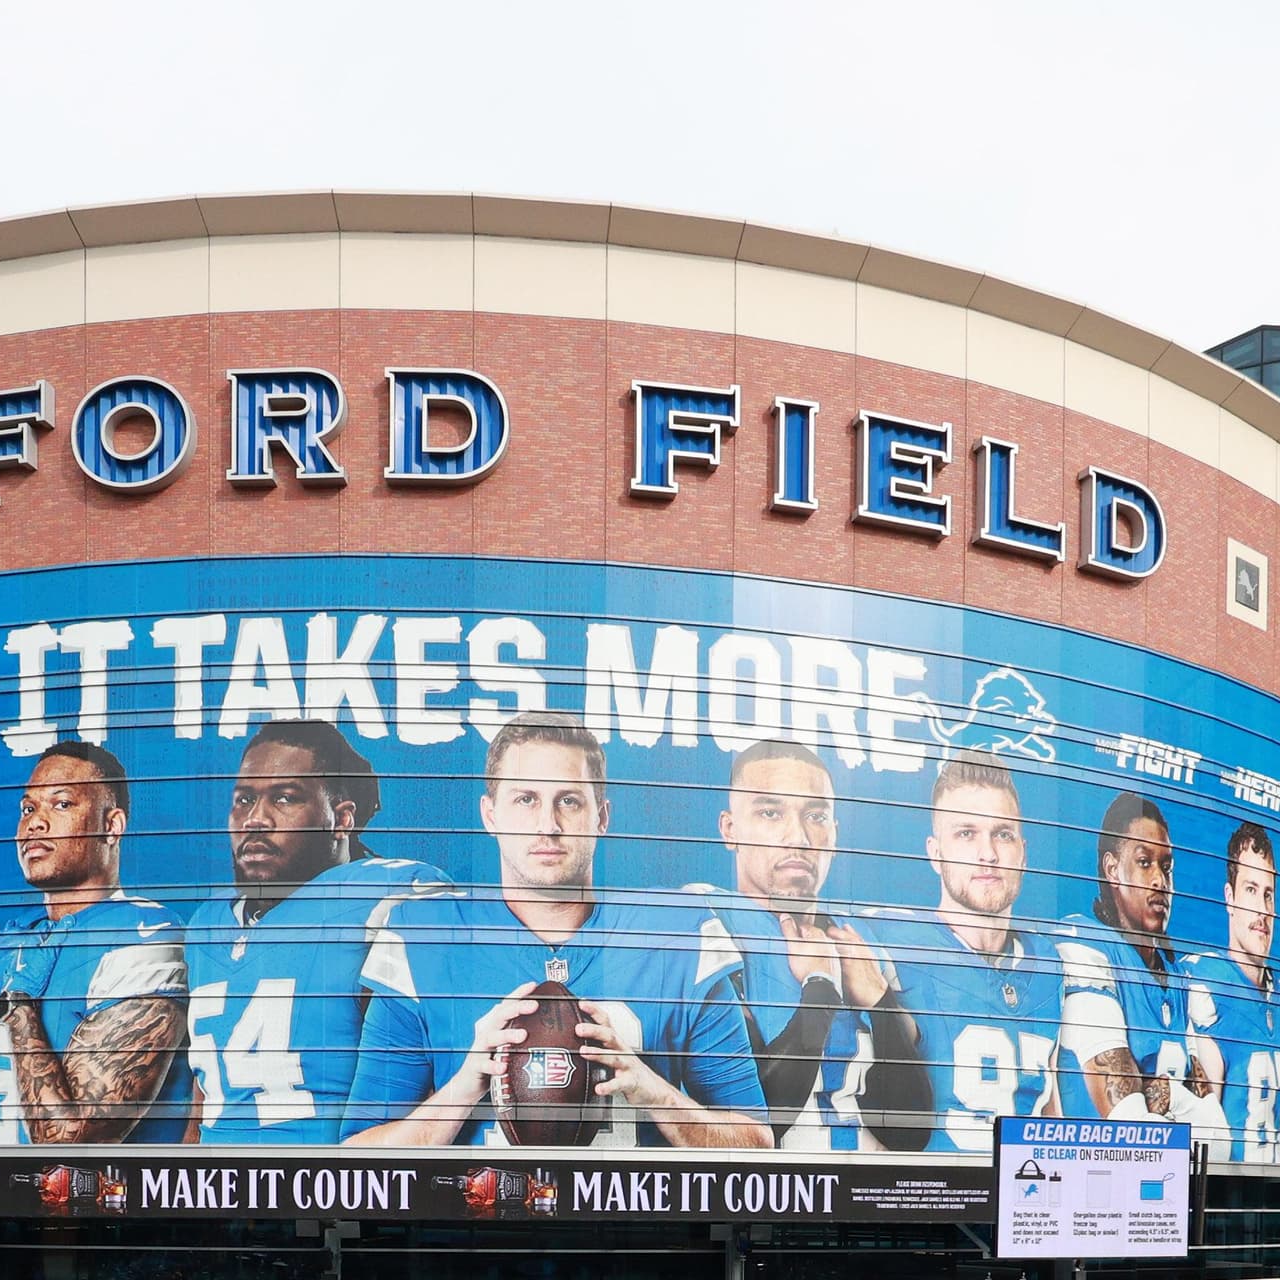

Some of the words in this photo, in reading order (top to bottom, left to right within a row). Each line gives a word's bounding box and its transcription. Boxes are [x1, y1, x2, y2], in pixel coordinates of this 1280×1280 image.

[629, 379, 1167, 582] FIELD
[3, 620, 135, 757] IT
[149, 613, 546, 744] TAKES
[584, 622, 929, 773] MORE
[1116, 732, 1203, 785] FIGHT
[187, 978, 317, 1127] 54
[1023, 1123, 1077, 1142] CLEAR
[1079, 1124, 1113, 1143] BAG
[1115, 1125, 1172, 1145] POLICY
[1033, 1148, 1046, 1159] BE
[1048, 1148, 1077, 1160] CLEAR
[1080, 1149, 1091, 1161] ON
[1094, 1149, 1132, 1162] STADIUM
[1134, 1150, 1163, 1162] SAFETY
[141, 1168, 238, 1211] MAKE
[247, 1168, 286, 1210] IT
[292, 1168, 417, 1211] COUNT
[572, 1170, 674, 1213] MAKE
[679, 1172, 718, 1213] IT
[723, 1172, 840, 1214] COUNT
